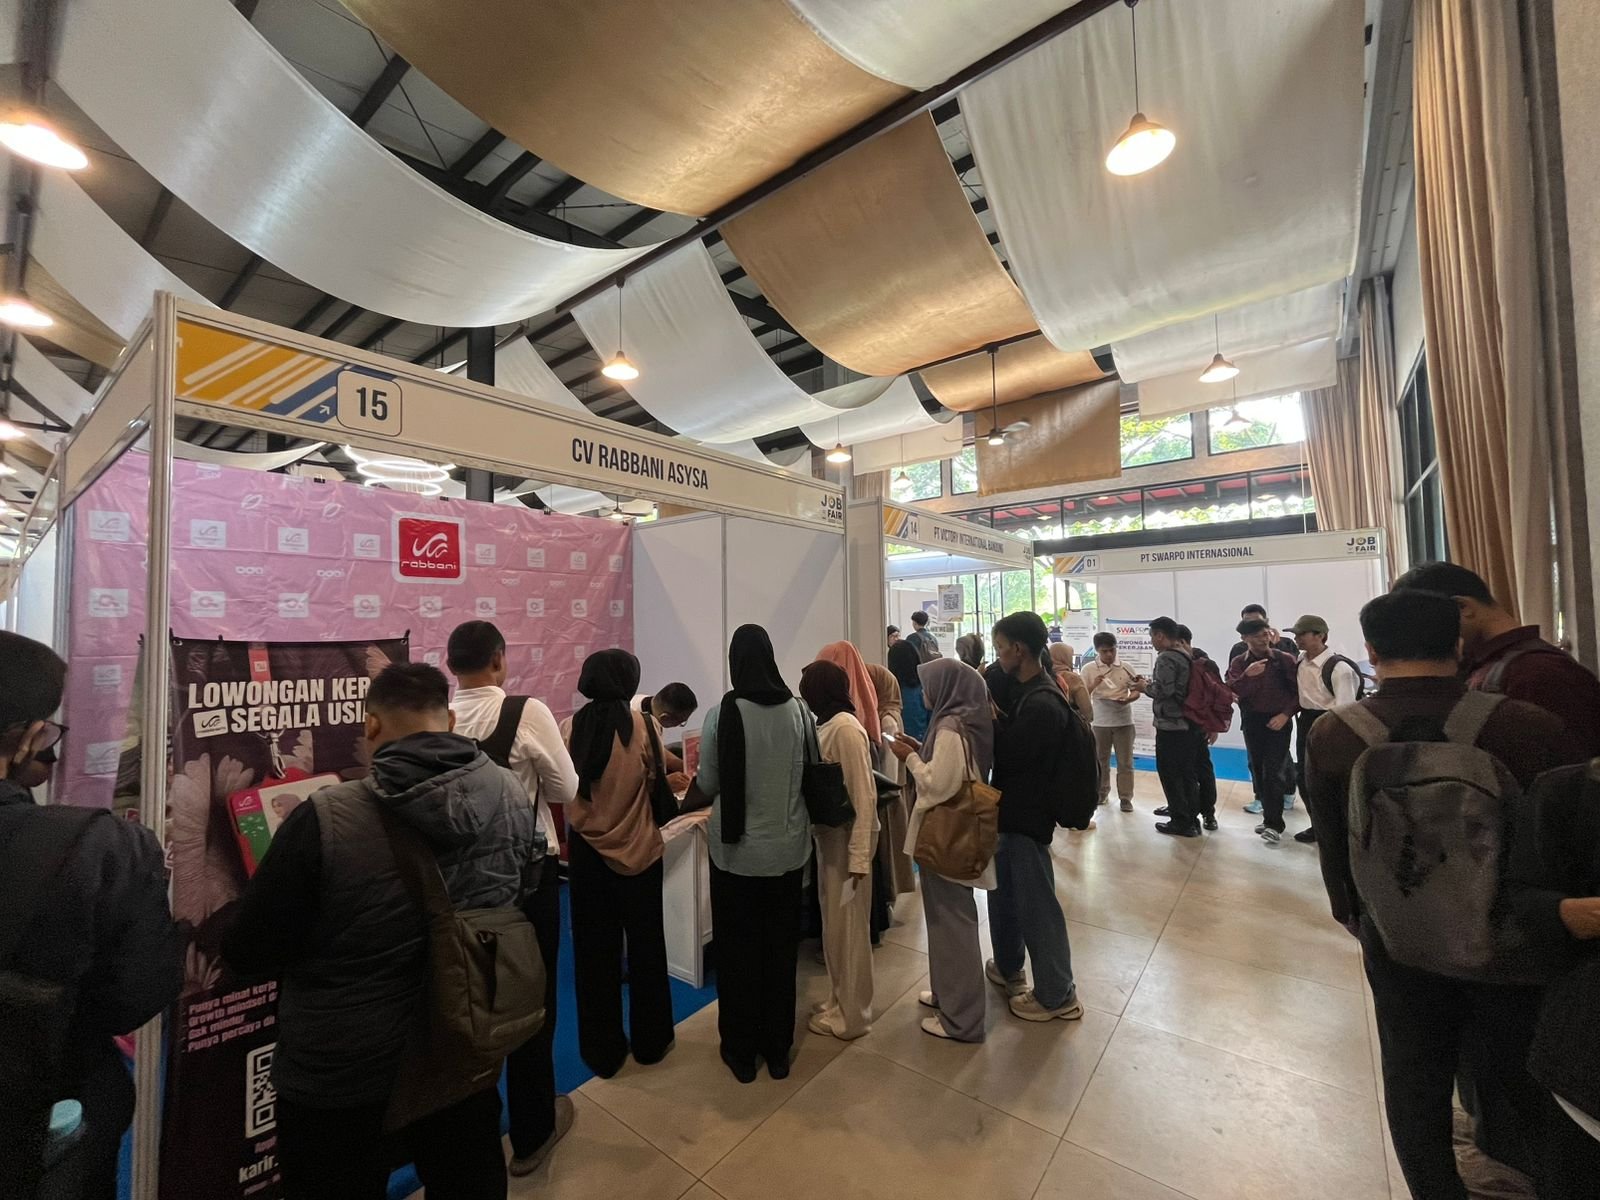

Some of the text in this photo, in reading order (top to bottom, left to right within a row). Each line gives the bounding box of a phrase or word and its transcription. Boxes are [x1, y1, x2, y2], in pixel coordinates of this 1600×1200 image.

[356, 387, 388, 421] 15
[572, 438, 709, 490] CV RABBANI ASYSA
[821, 494, 842, 510] JOB
[827, 509, 842, 520] FAIR
[910, 521, 917, 535] 14
[934, 526, 940, 539] PT
[941, 528, 959, 543] VICTORY
[1346, 536, 1376, 546] JOB
[1087, 559, 1096, 567] 01
[1140, 547, 1254, 563] PT SWARPO INTERNASIONAL
[401, 560, 457, 570] rabbani
[188, 676, 371, 709] LOWONGAN KER
[231, 703, 321, 733] SEGALA
[239, 1154, 279, 1183] karir.
